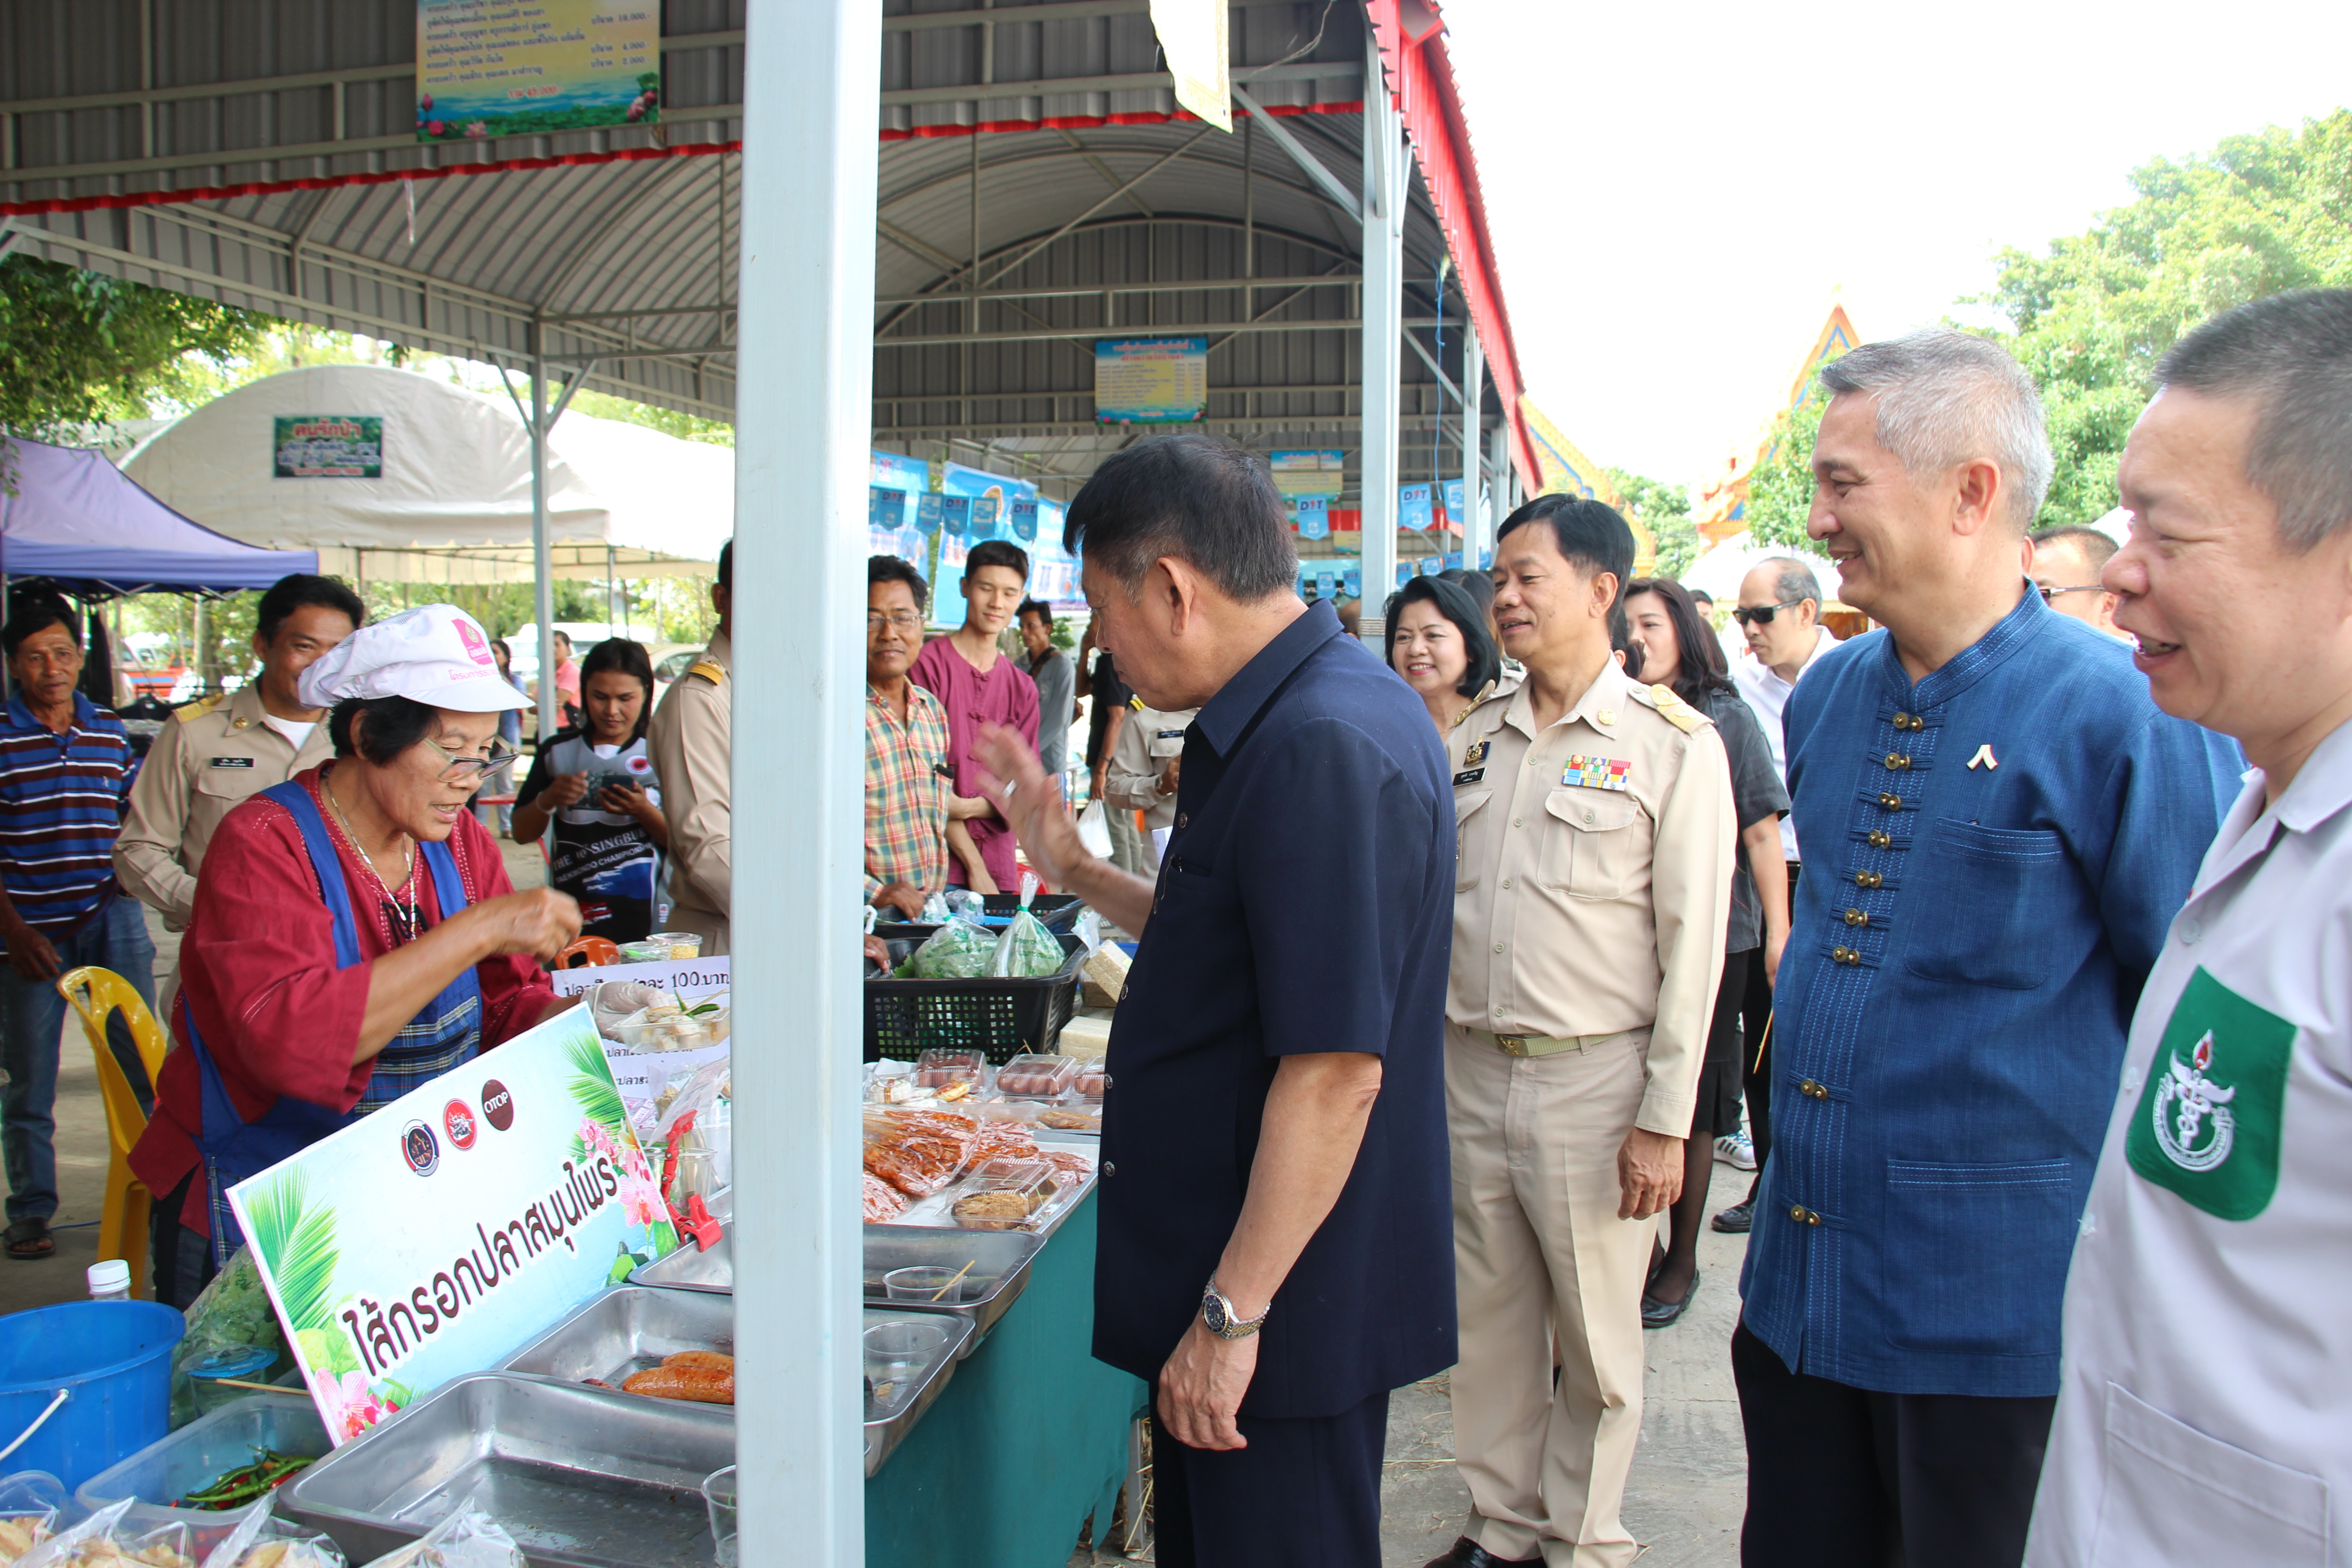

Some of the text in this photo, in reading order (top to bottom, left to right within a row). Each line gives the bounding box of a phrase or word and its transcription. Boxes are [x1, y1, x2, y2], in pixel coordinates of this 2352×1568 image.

[1404, 490, 1427, 501] DIT
[946, 498, 968, 509] DIT
[1014, 503, 1036, 514] DIT
[1300, 500, 1323, 511] DIT
[484, 1091, 509, 1114] OTOP
[343, 1155, 617, 1377] ไส้กรอกปลาสมุนไพร
